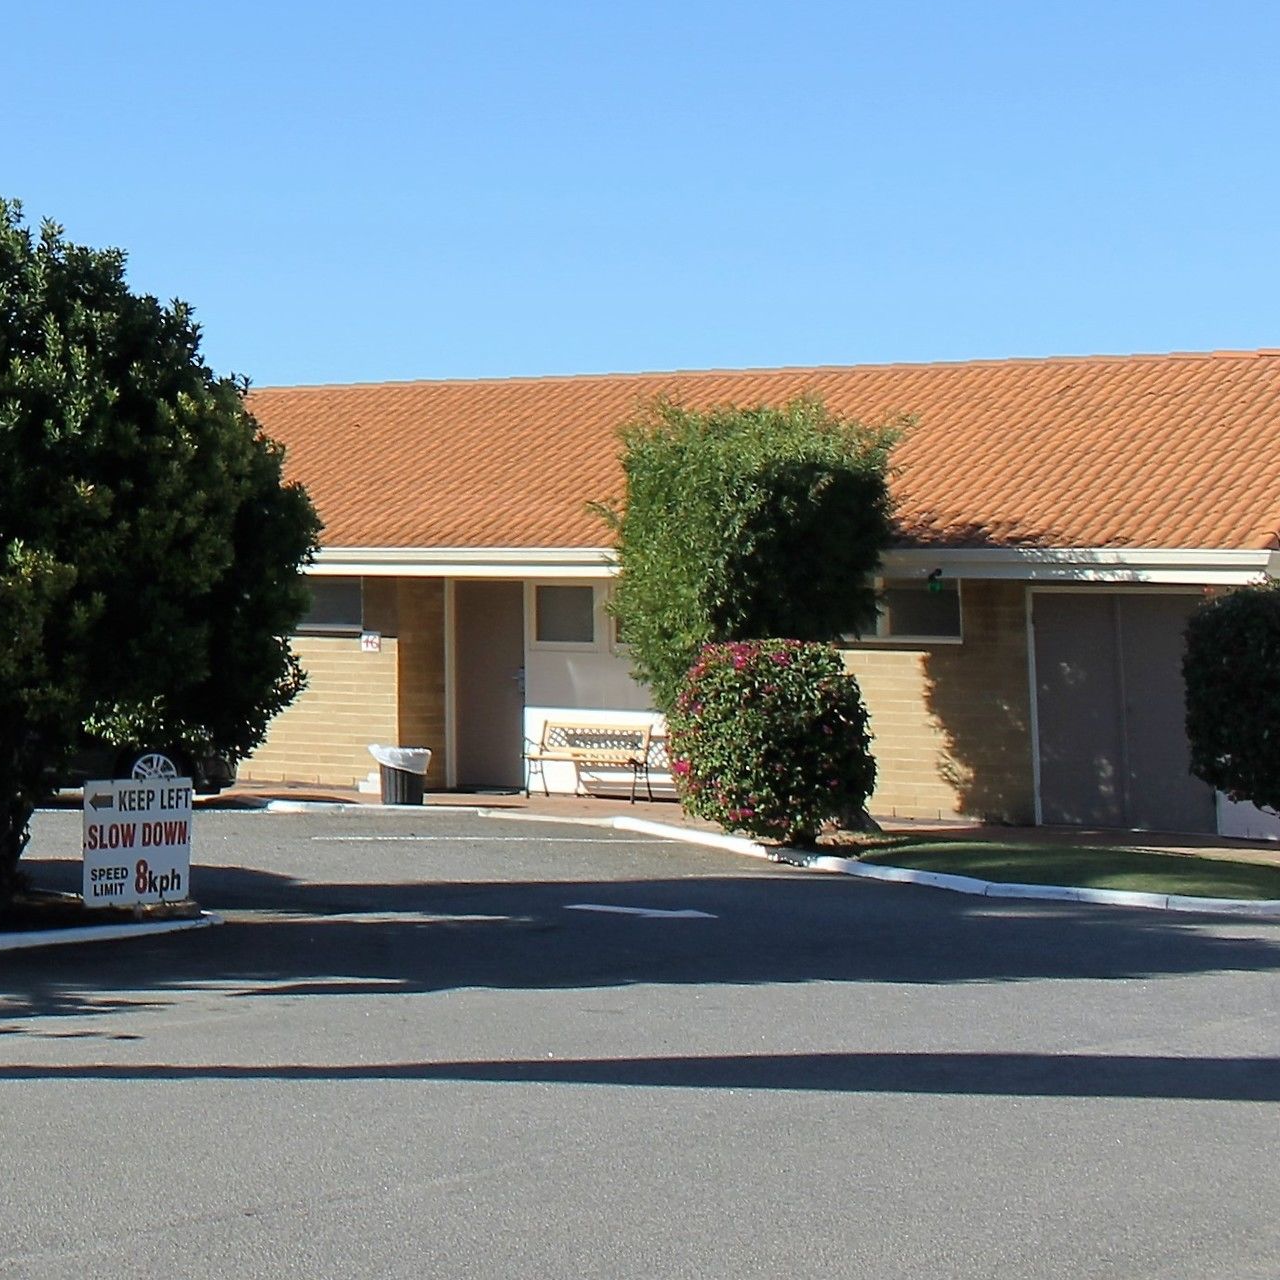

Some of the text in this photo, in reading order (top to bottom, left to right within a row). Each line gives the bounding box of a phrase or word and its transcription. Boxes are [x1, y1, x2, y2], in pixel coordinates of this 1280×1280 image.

[118, 787, 190, 812] KEEP LEFT
[88, 821, 188, 850] SLOW DOWN
[91, 867, 129, 882] SPEED
[134, 859, 181, 898] 8kph
[93, 882, 125, 897] LIMIT
